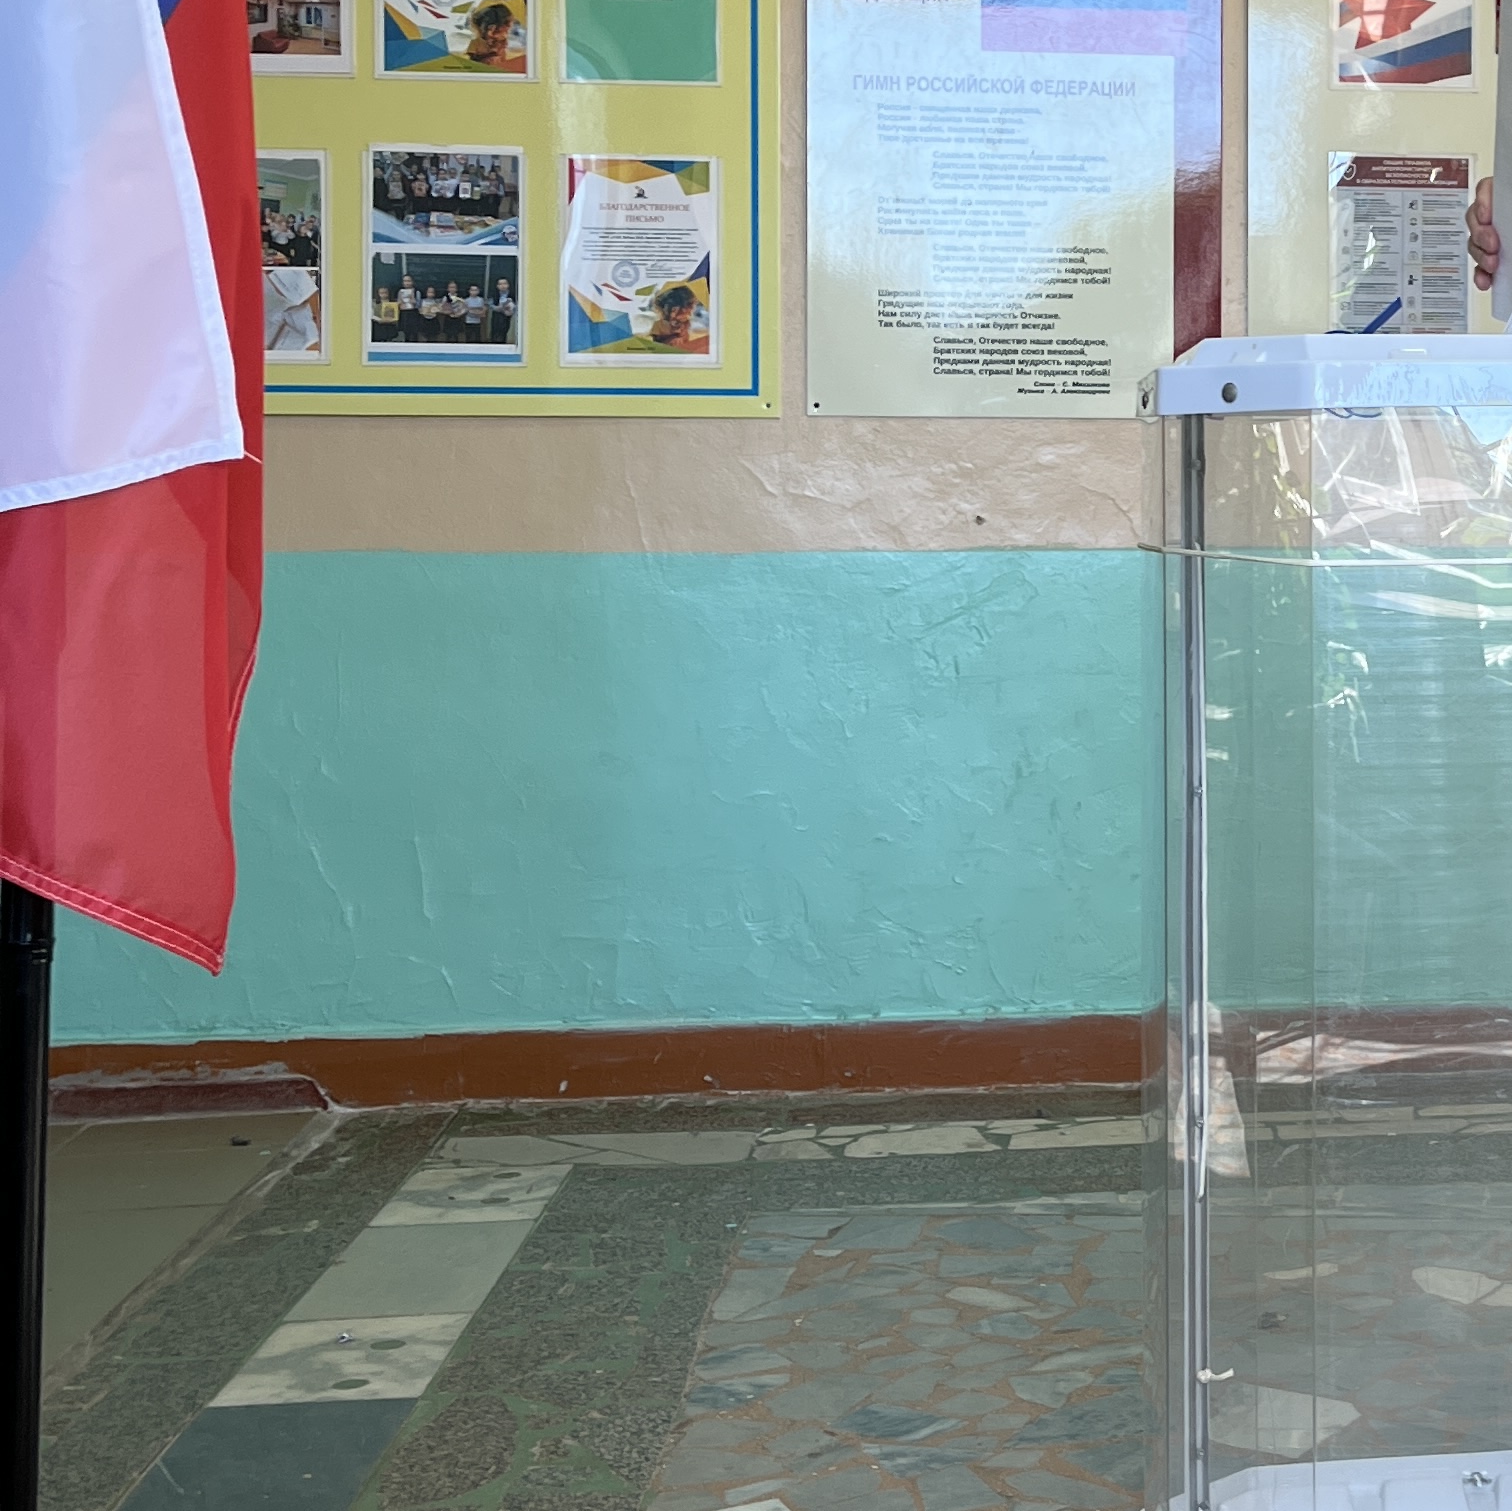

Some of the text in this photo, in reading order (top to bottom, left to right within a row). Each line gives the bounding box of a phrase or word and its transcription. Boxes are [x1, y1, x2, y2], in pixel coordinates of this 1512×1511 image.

[852, 72, 1136, 99] ГИМН РОССИЙСКОЙ ФЕДЕРАЦИИ
